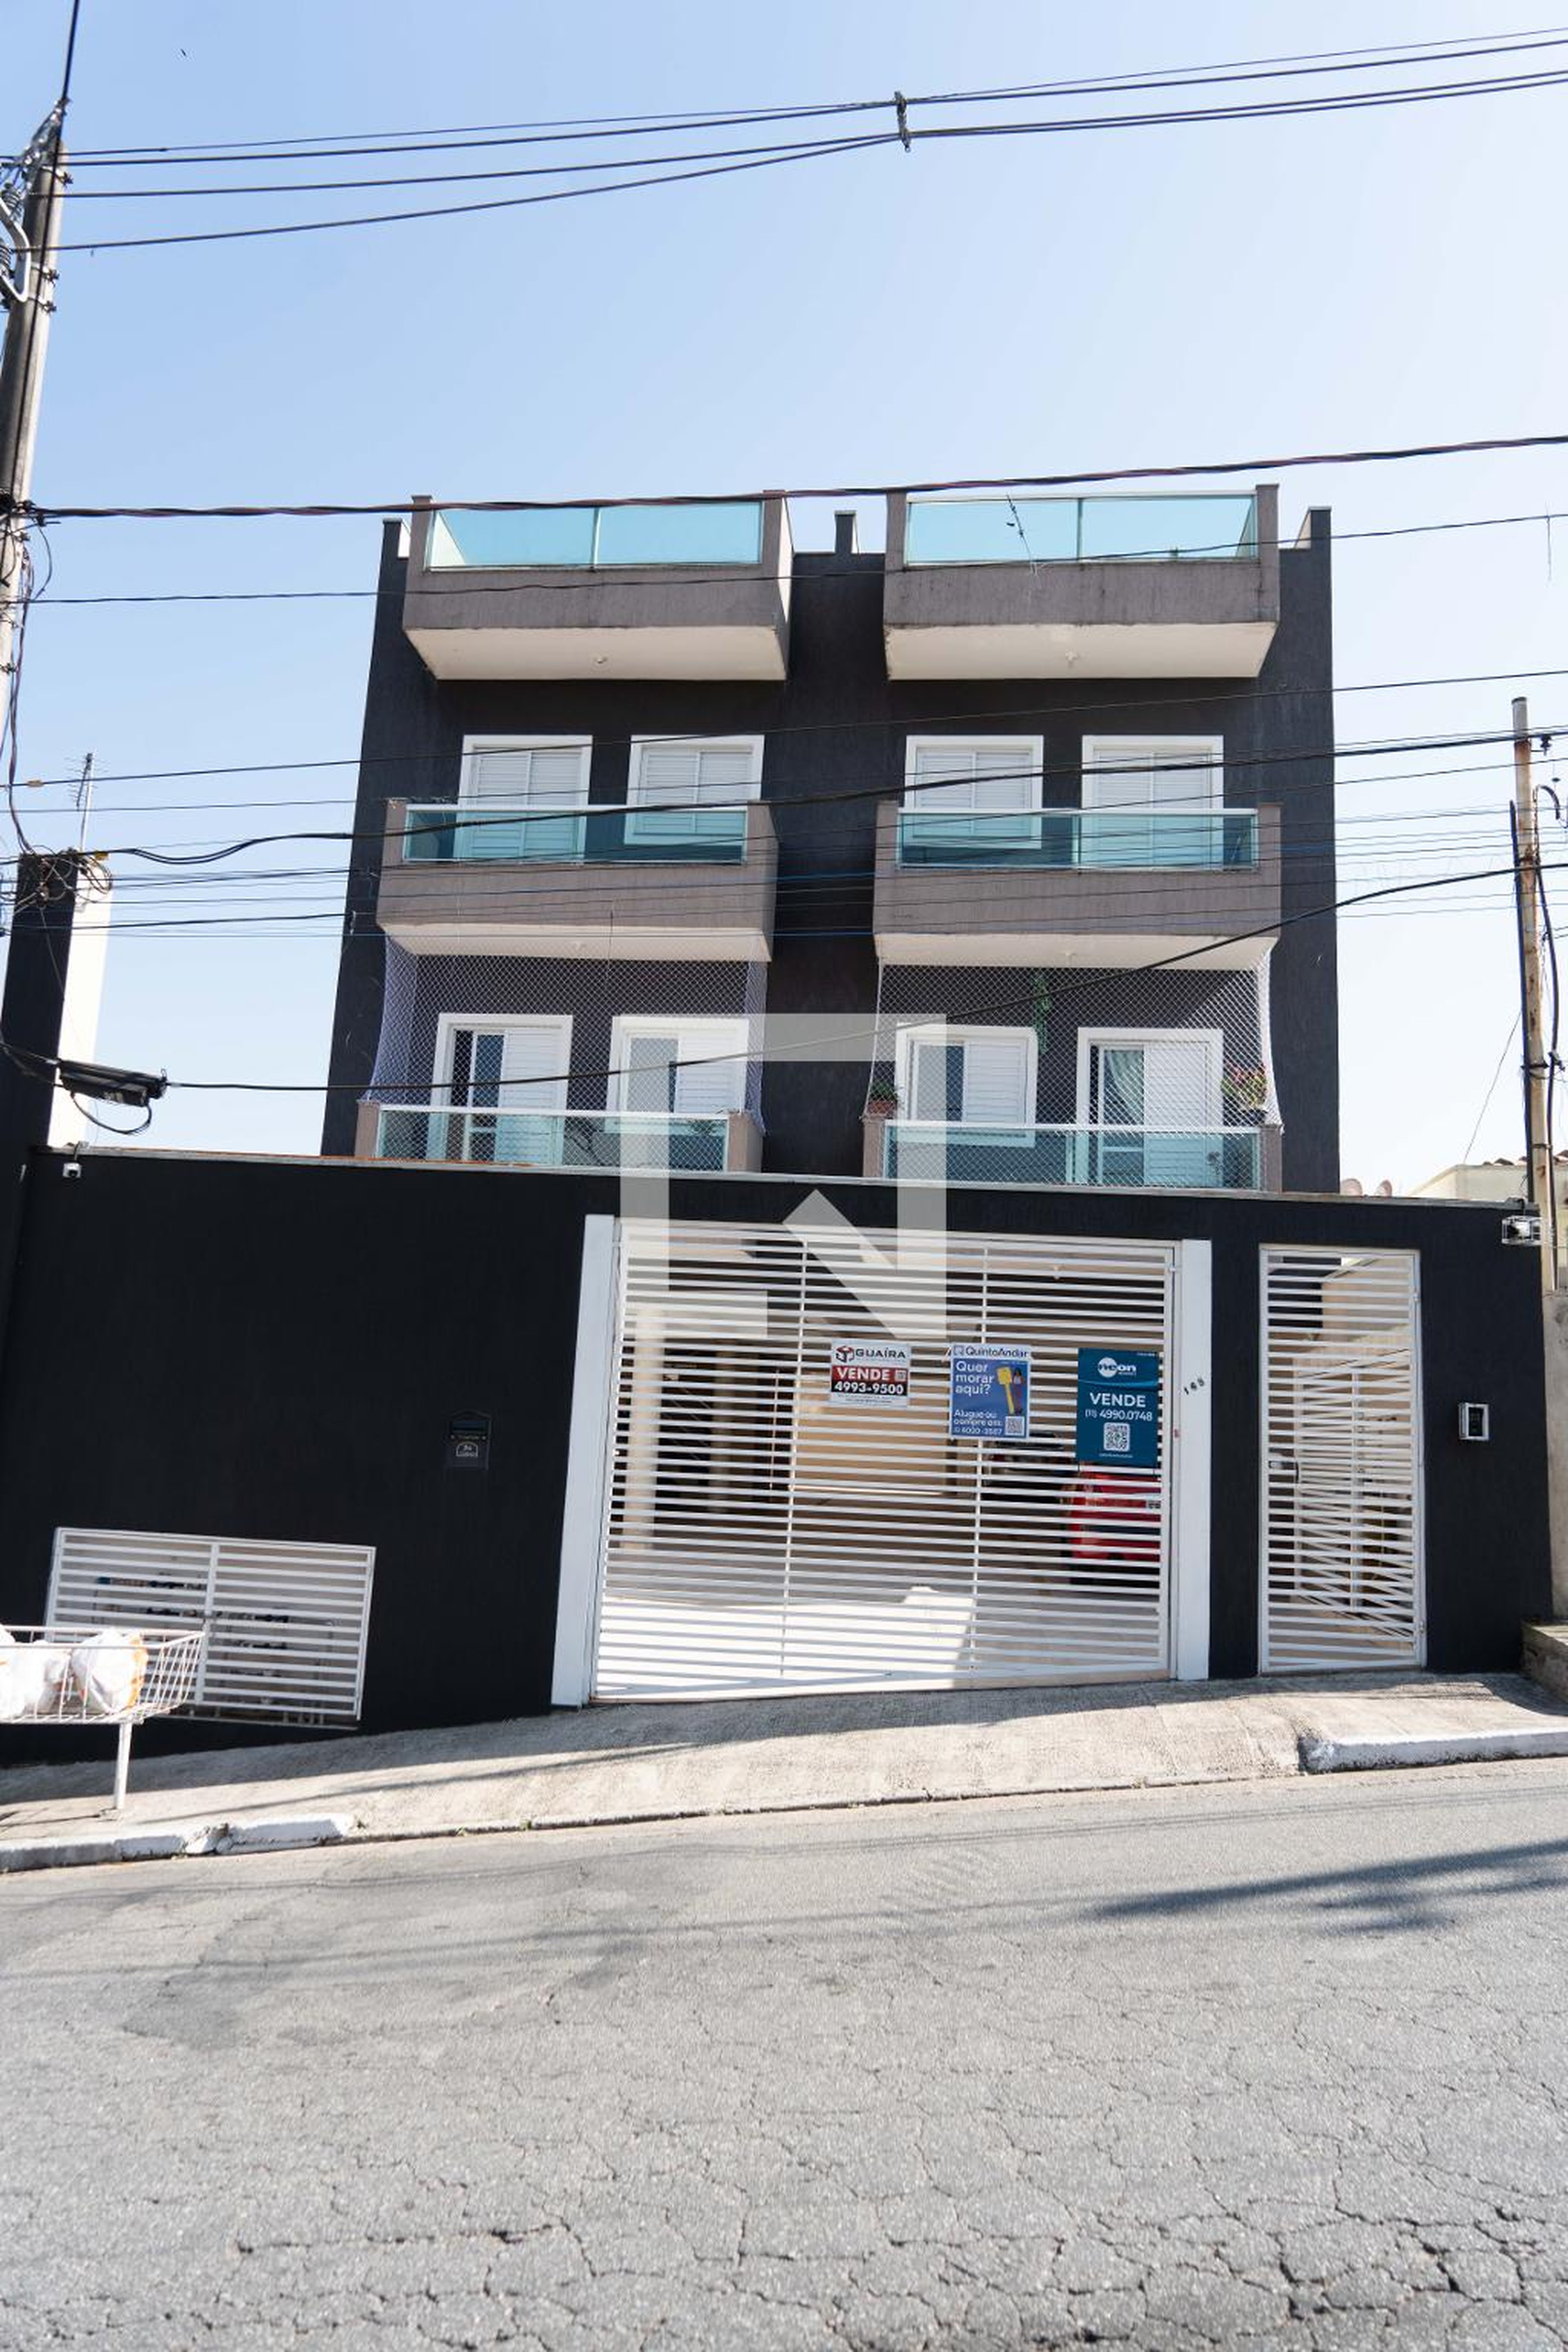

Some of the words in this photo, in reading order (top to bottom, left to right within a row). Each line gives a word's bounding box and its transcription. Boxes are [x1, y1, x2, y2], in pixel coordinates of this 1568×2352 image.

[855, 1347, 906, 1359] GUAÍRA
[965, 1346, 1029, 1357] QuintoAndar
[956, 1361, 988, 1372] Quer
[837, 1368, 891, 1381] VENDE
[956, 1374, 994, 1383] morar
[834, 1381, 904, 1394] 4993-9500
[956, 1383, 991, 1396] aqui?
[1089, 1392, 1146, 1408] VENDE
[1099, 1409, 1153, 1422] 4990.0748
